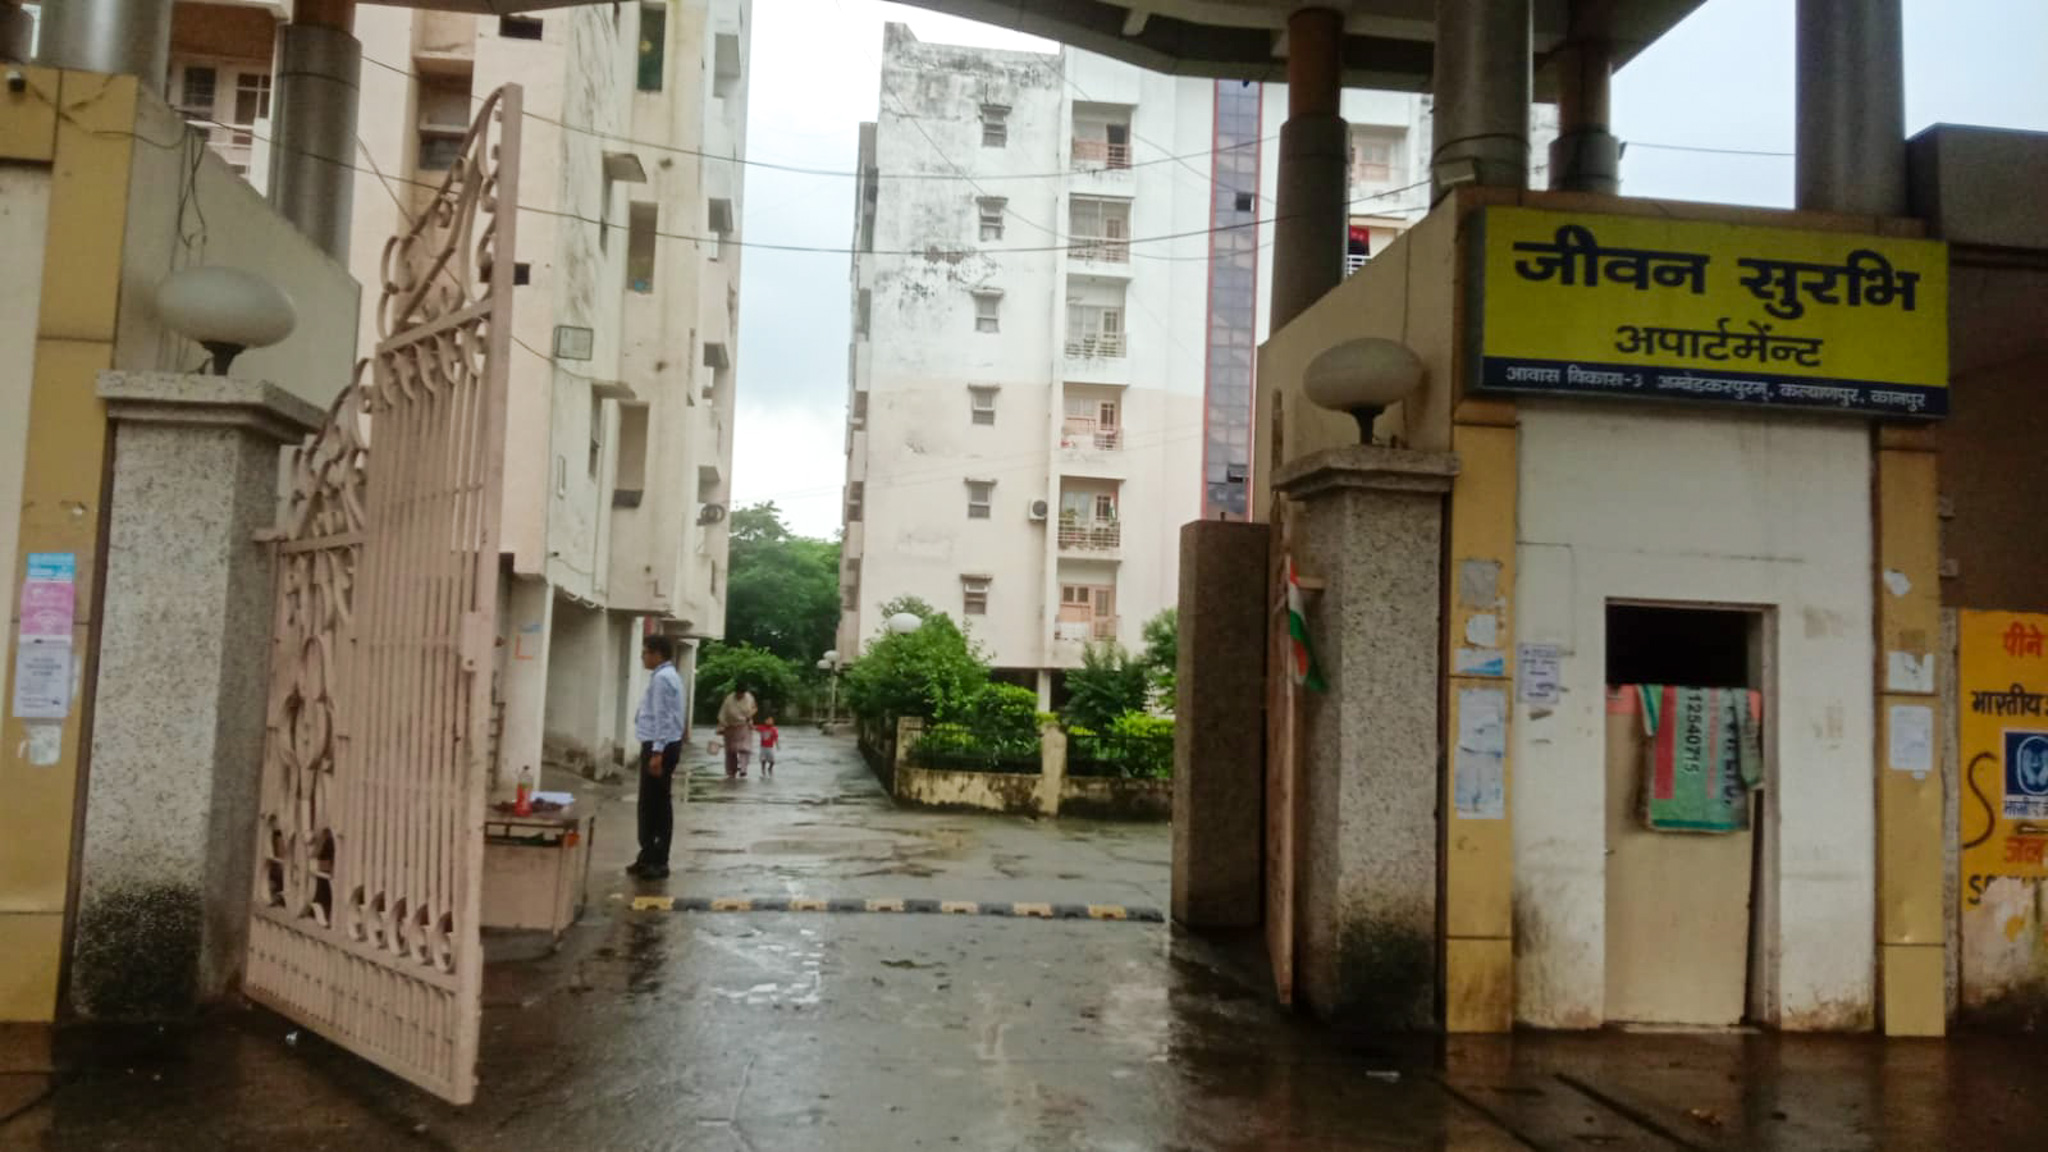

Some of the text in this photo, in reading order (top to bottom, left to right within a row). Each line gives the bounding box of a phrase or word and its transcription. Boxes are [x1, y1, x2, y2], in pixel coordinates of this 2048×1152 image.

[1513, 224, 1921, 320] जीवन सुरभि
[1505, 366, 1561, 384] आवास
[1870, 390, 1926, 412] कानपुर
[1971, 683, 2043, 717] भारतीय
